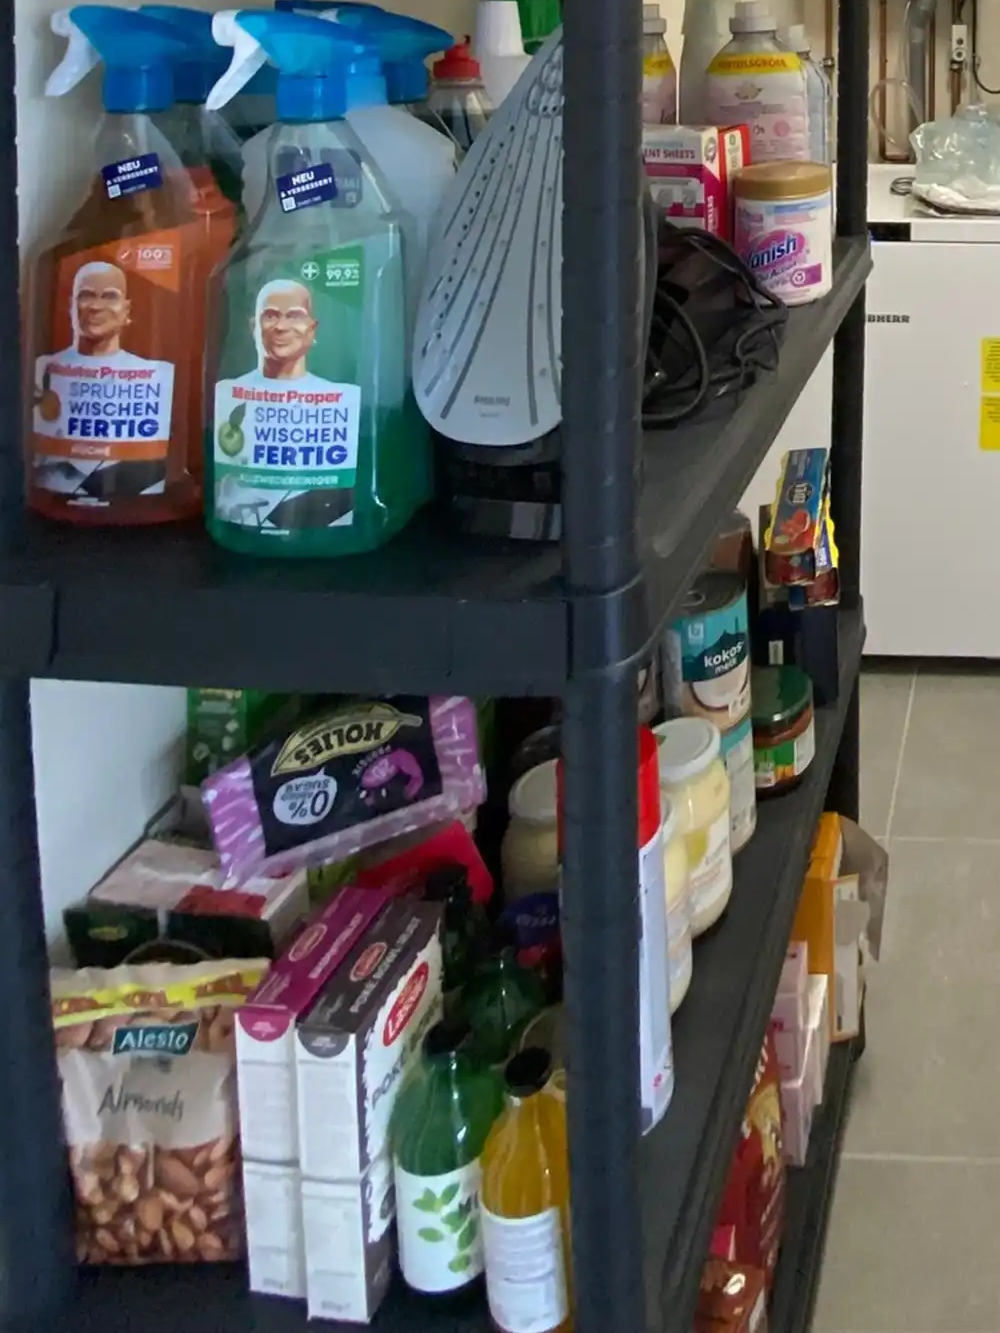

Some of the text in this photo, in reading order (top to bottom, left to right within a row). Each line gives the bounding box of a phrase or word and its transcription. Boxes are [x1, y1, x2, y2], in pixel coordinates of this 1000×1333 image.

[663, 149, 696, 159] SHEETS
[113, 166, 158, 184] VERBESSERT
[118, 160, 140, 173] NEU
[287, 177, 333, 197] VERBESSERT
[292, 171, 314, 186] NEU
[69, 401, 159, 417] WISCHEN
[254, 404, 349, 424] SPRÜHEN
[68, 417, 159, 438] FERTIG
[254, 426, 348, 443] WISCHEN
[253, 444, 348, 466] FERTIG
[704, 641, 745, 668] kokos
[286, 778, 331, 793] SUGAR
[288, 789, 329, 818] 0%
[119, 1028, 189, 1051] Alesto
[97, 1084, 184, 1120] Almonds
